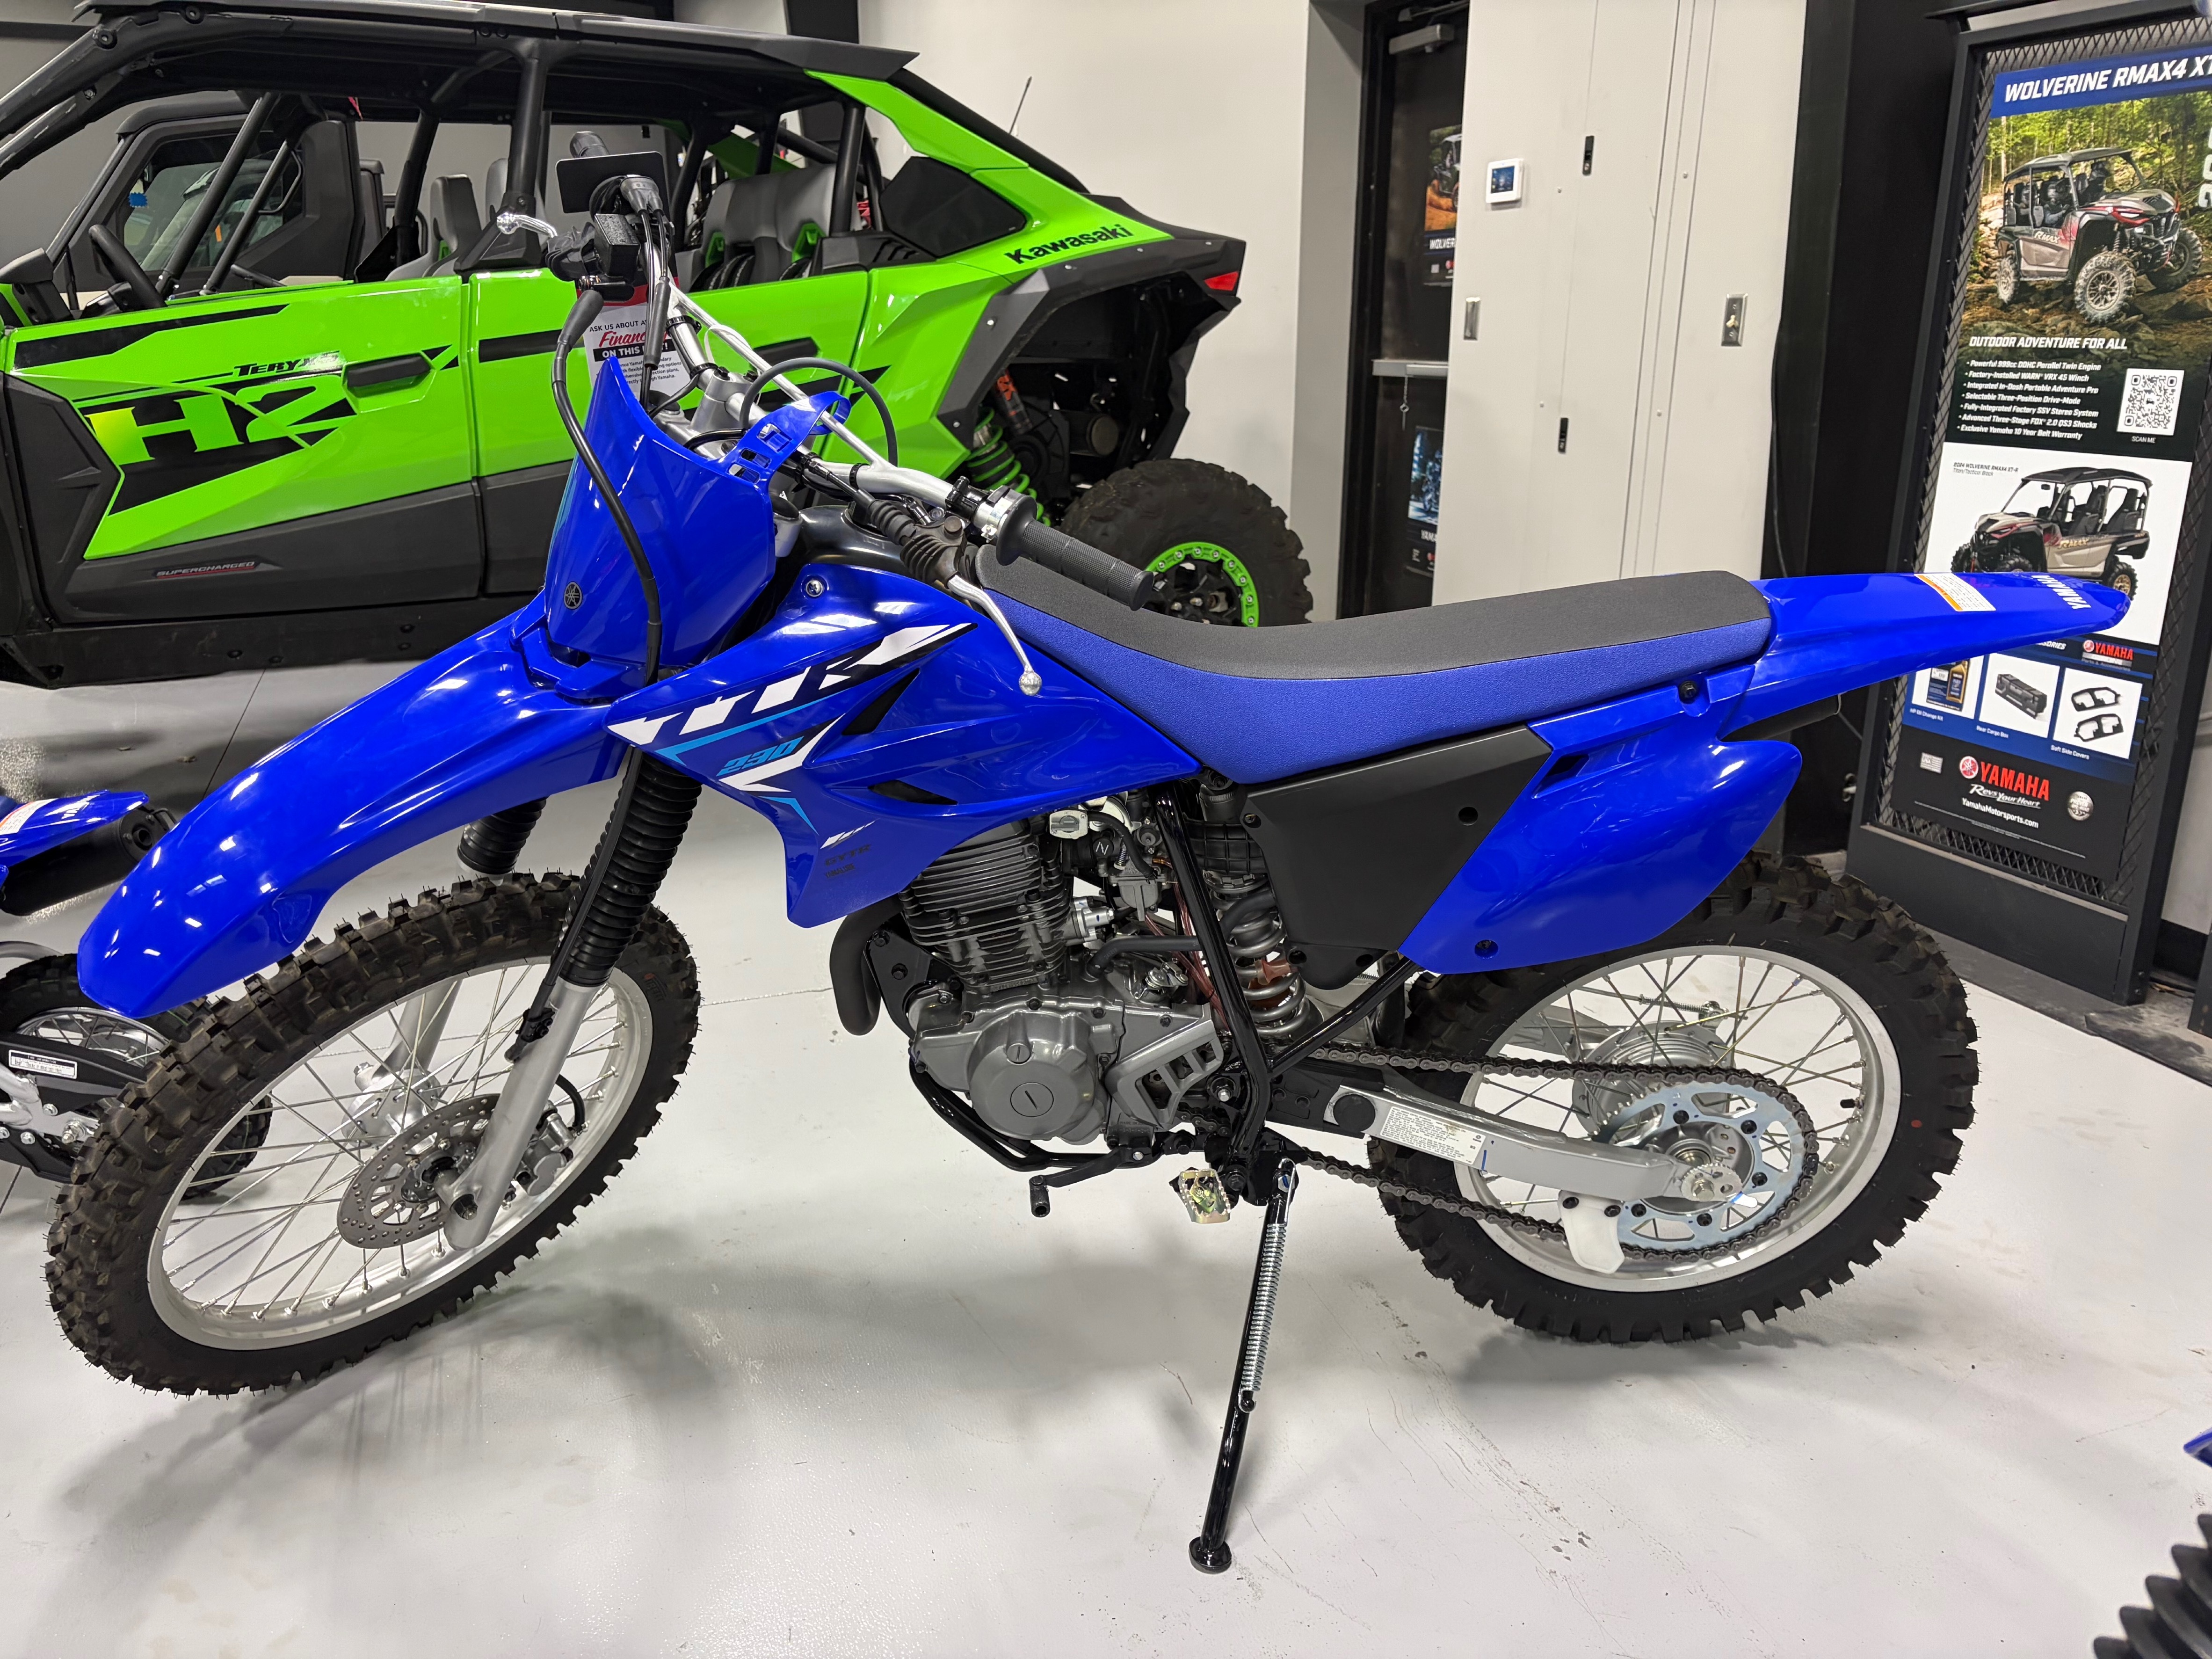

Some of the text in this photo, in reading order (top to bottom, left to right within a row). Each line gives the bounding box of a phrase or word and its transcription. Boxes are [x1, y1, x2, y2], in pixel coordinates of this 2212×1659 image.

[2005, 69, 2111, 102] WOLVERINE
[2112, 58, 2188, 88] RMAX4
[1004, 224, 1134, 264] Kawasaki
[616, 320, 639, 328] ABOUT
[1969, 336, 2128, 349] OUTDOOR ADVENTURE FOR ALL
[602, 349, 617, 358] ON
[618, 346, 640, 357] THIS
[1968, 371, 2021, 379] Factory-Installed
[2078, 363, 2102, 371] Engine
[1967, 381, 1999, 390] Integrated
[2051, 385, 2086, 393] Adventure
[1965, 392, 2081, 405] Selectable Three-Position Drive-Mode
[1964, 403, 2013, 412] Fully-Integrated
[2012, 405, 2037, 415] Factory
[2073, 408, 2099, 417] System
[84, 375, 359, 466] H2
[1962, 414, 1992, 422] Advanced
[1992, 415, 2030, 425] Three-Stage
[2072, 420, 2097, 429] Shocks
[1960, 424, 1989, 433] Exclusive
[2051, 430, 2083, 441] Warranty
[157, 561, 255, 577] SUPERCHARGED
[2031, 575, 2092, 610] YAMAHA
[2095, 642, 2133, 661] YAMAHA
[1922, 711, 1937, 720] Change
[1987, 728, 2000, 736] Cargo
[716, 735, 804, 777] 230
[2051, 744, 2090, 760] Soft Side Covers
[1980, 761, 2049, 801] YAMAHA
[1961, 797, 2039, 829] YamahaMotorsports.com
[825, 844, 871, 866] GYTR
